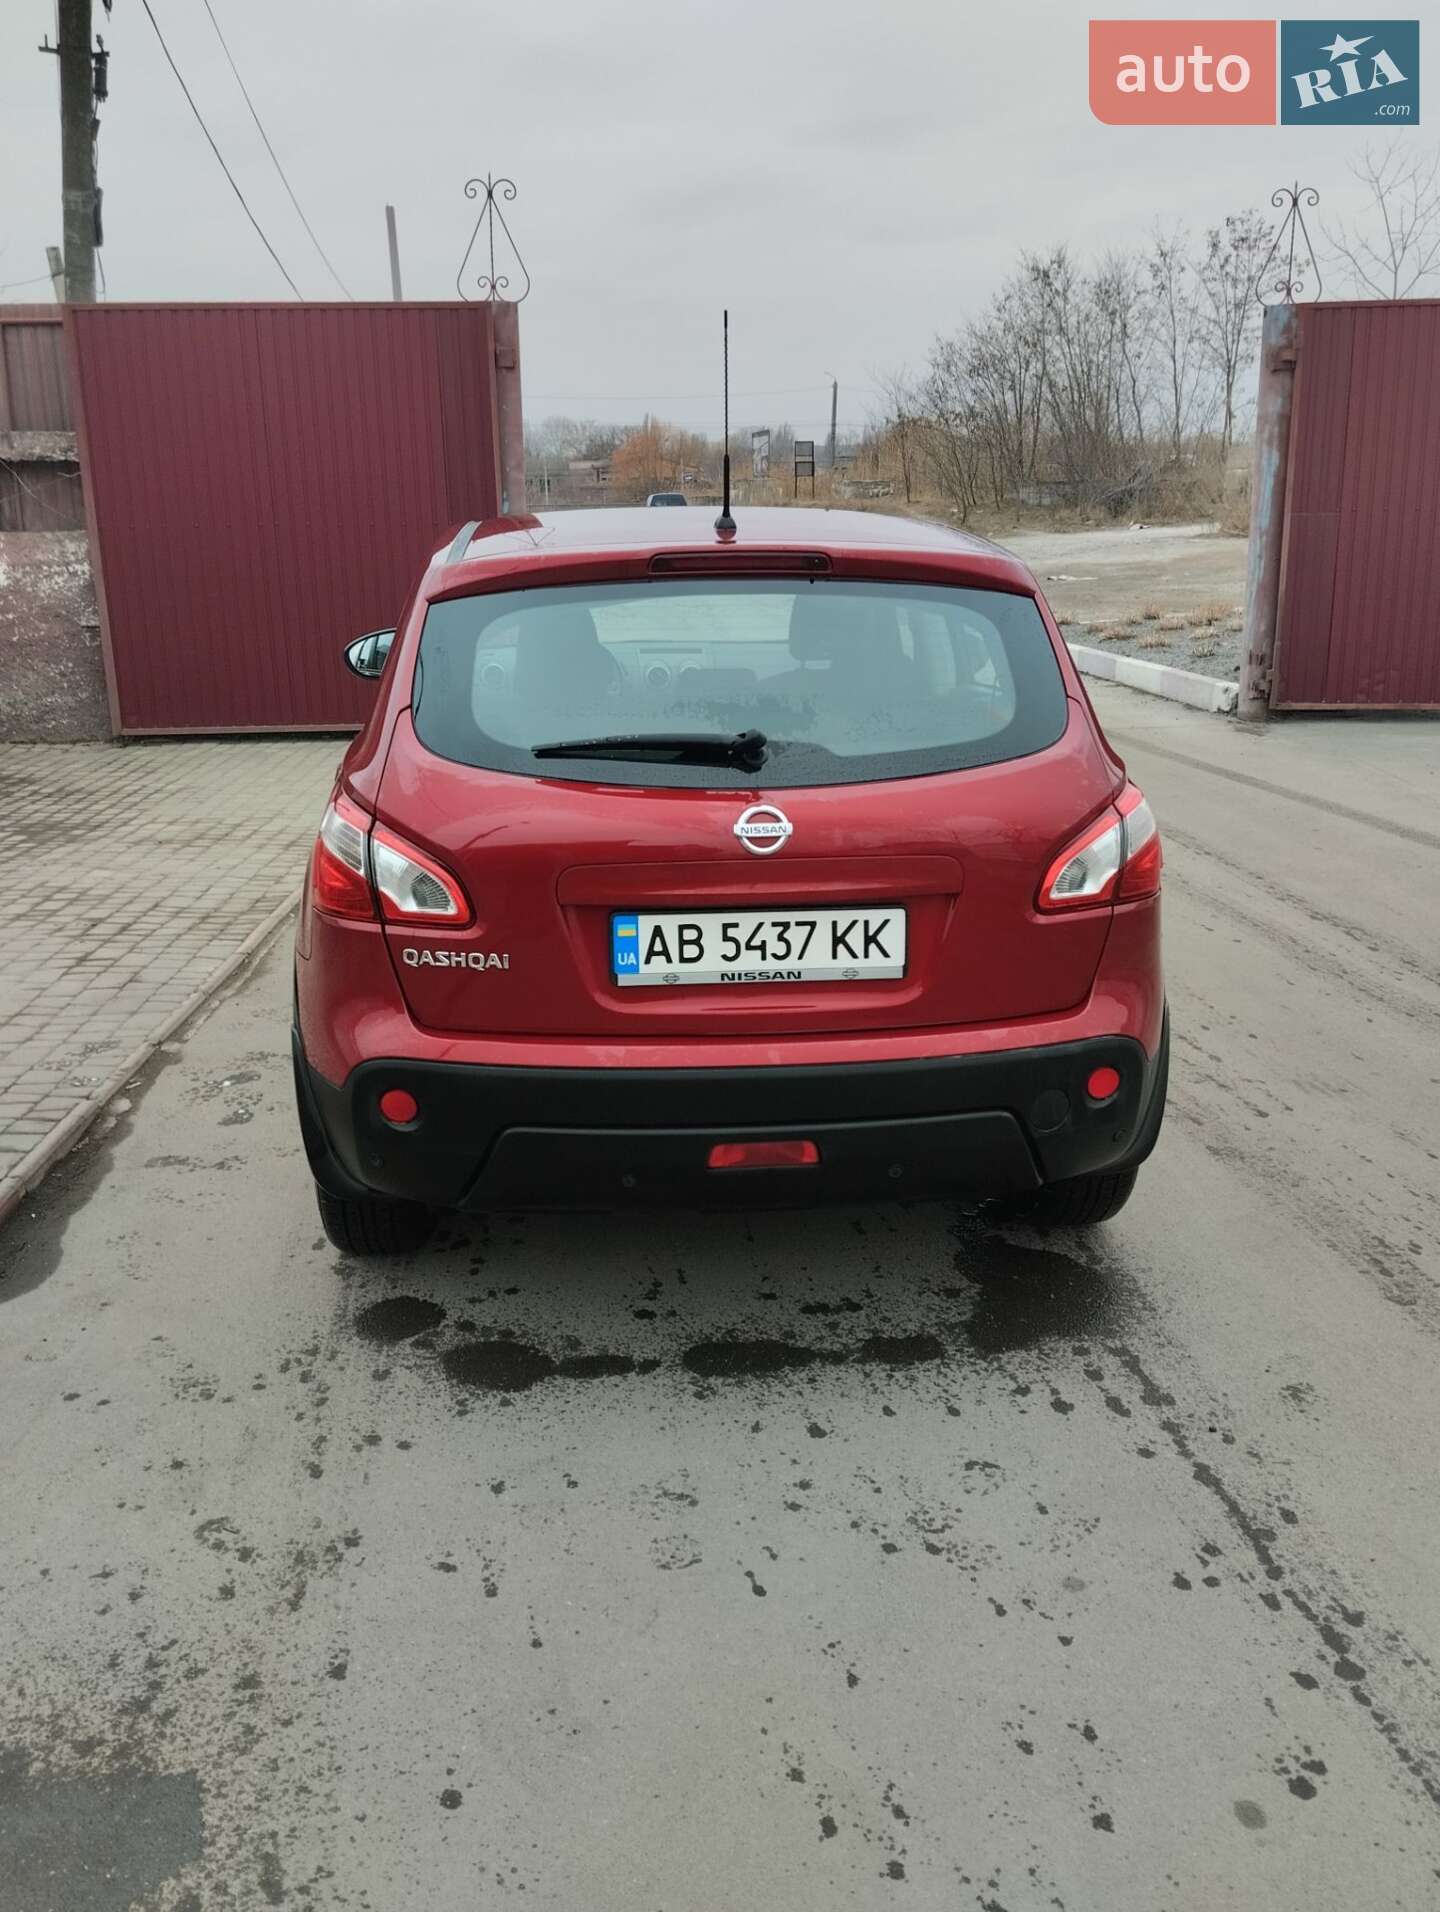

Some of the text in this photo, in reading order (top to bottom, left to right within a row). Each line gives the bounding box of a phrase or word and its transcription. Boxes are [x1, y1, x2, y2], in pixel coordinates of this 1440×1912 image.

[740, 824, 788, 836] NISSAN
[643, 918, 892, 965] AB 5437 KK
[617, 952, 638, 966] UA
[720, 970, 802, 983] NISSAN
